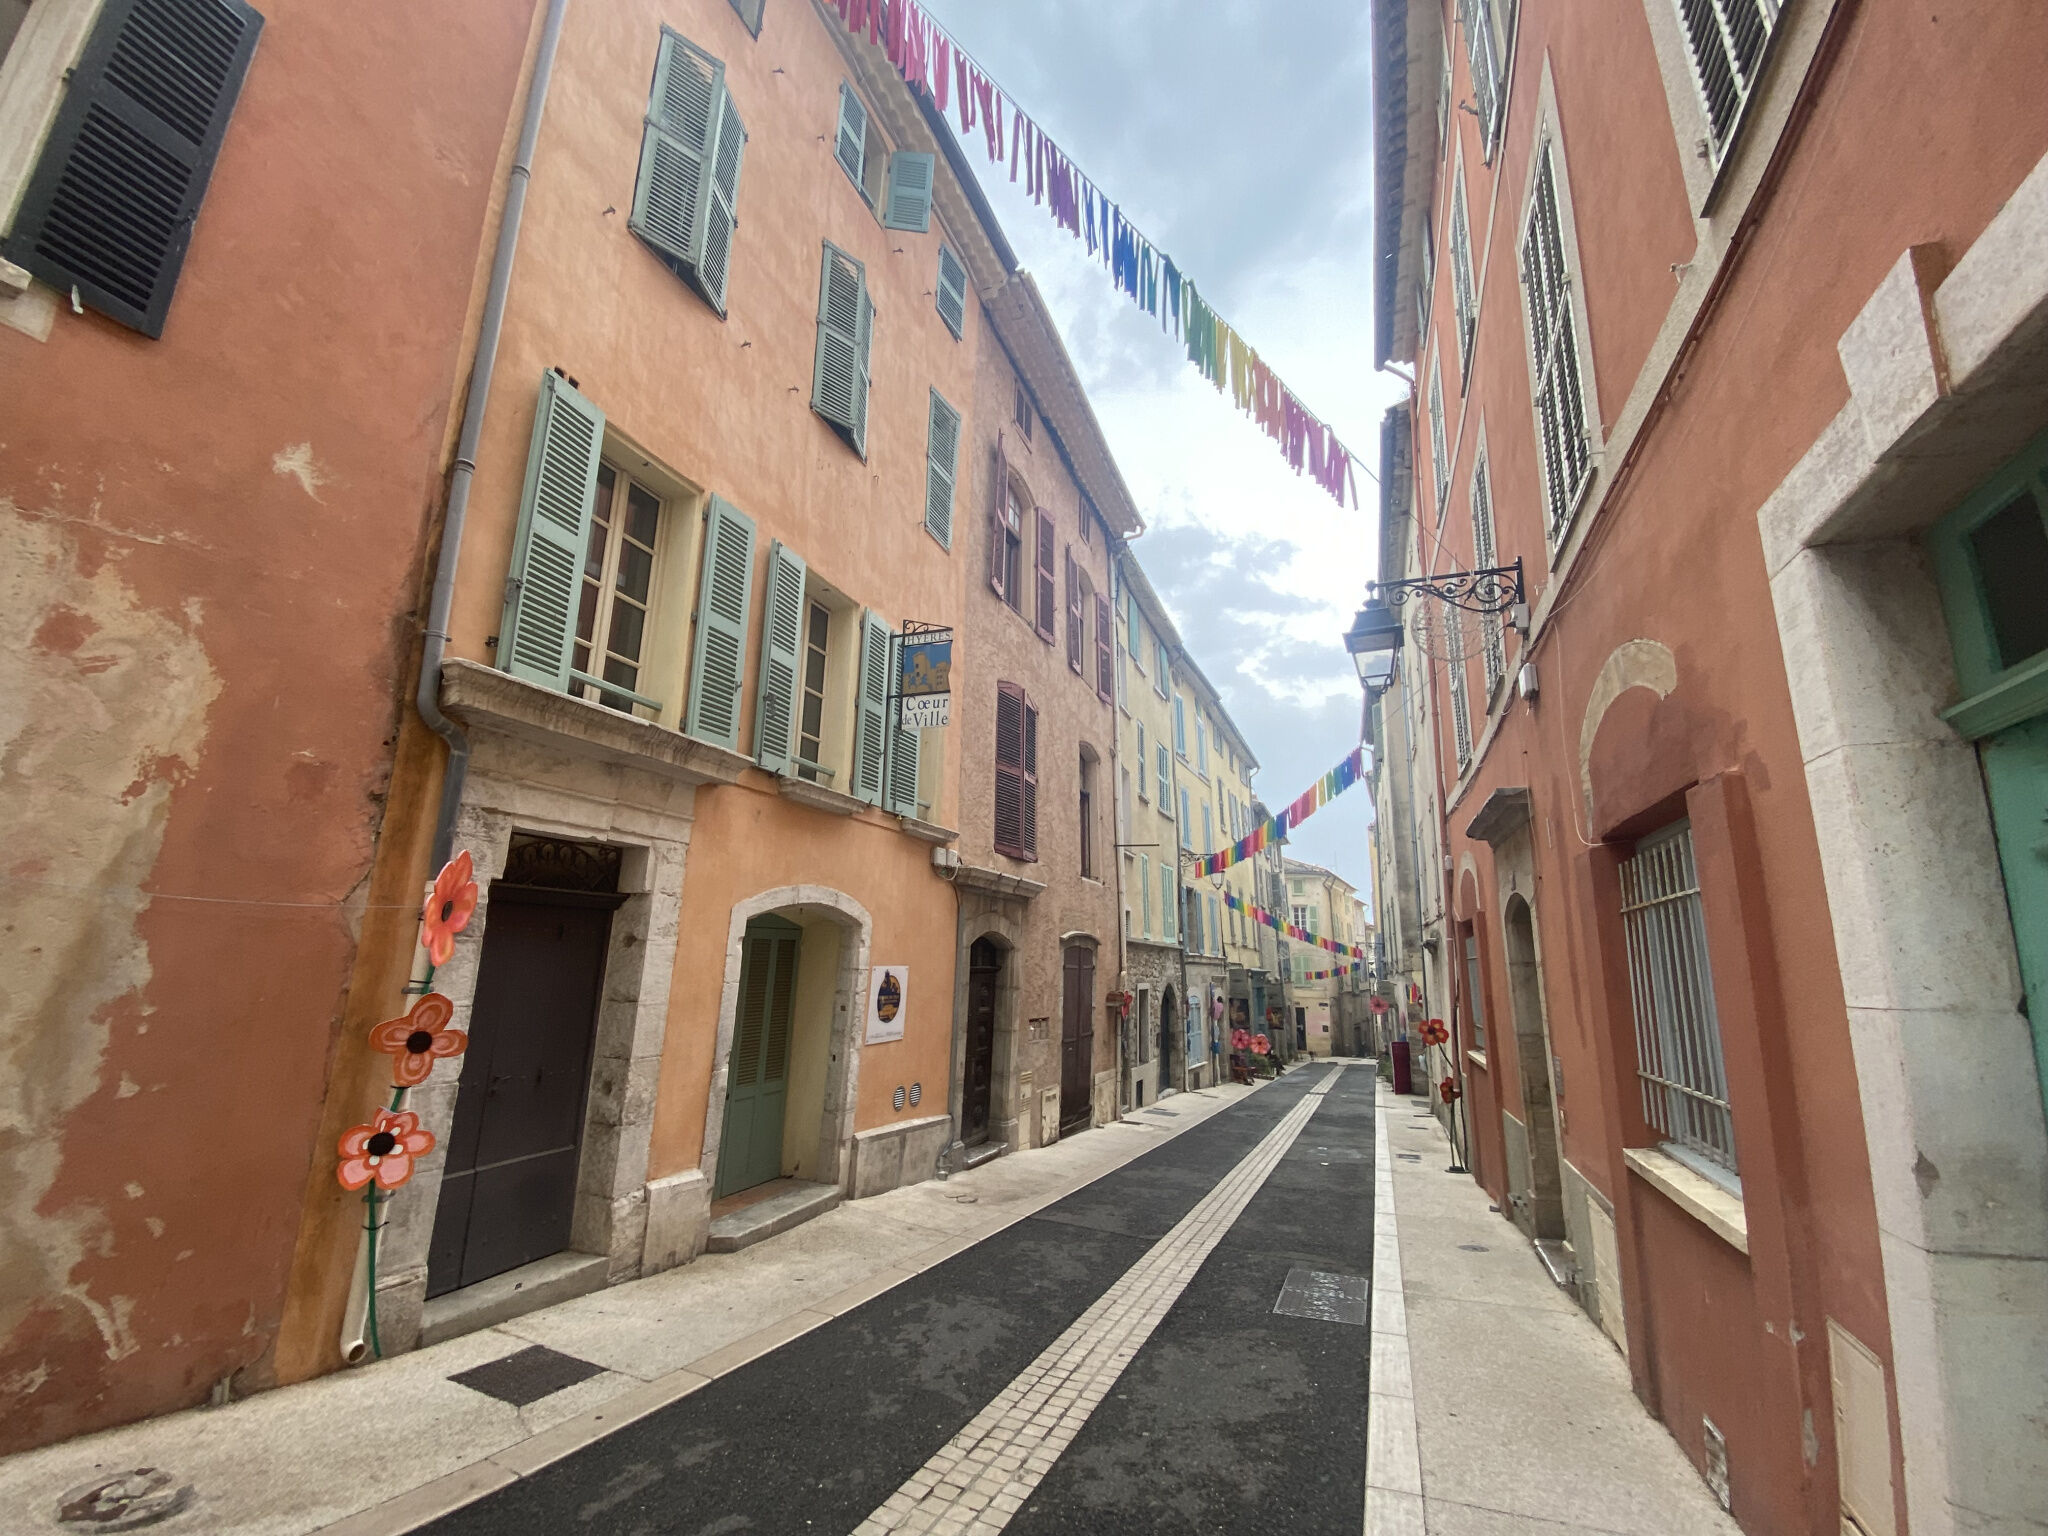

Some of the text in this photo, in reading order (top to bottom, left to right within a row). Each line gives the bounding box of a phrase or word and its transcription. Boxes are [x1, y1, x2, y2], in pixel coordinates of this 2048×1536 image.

[906, 696, 949, 711] Cœur
[902, 711, 948, 727] de Ville
